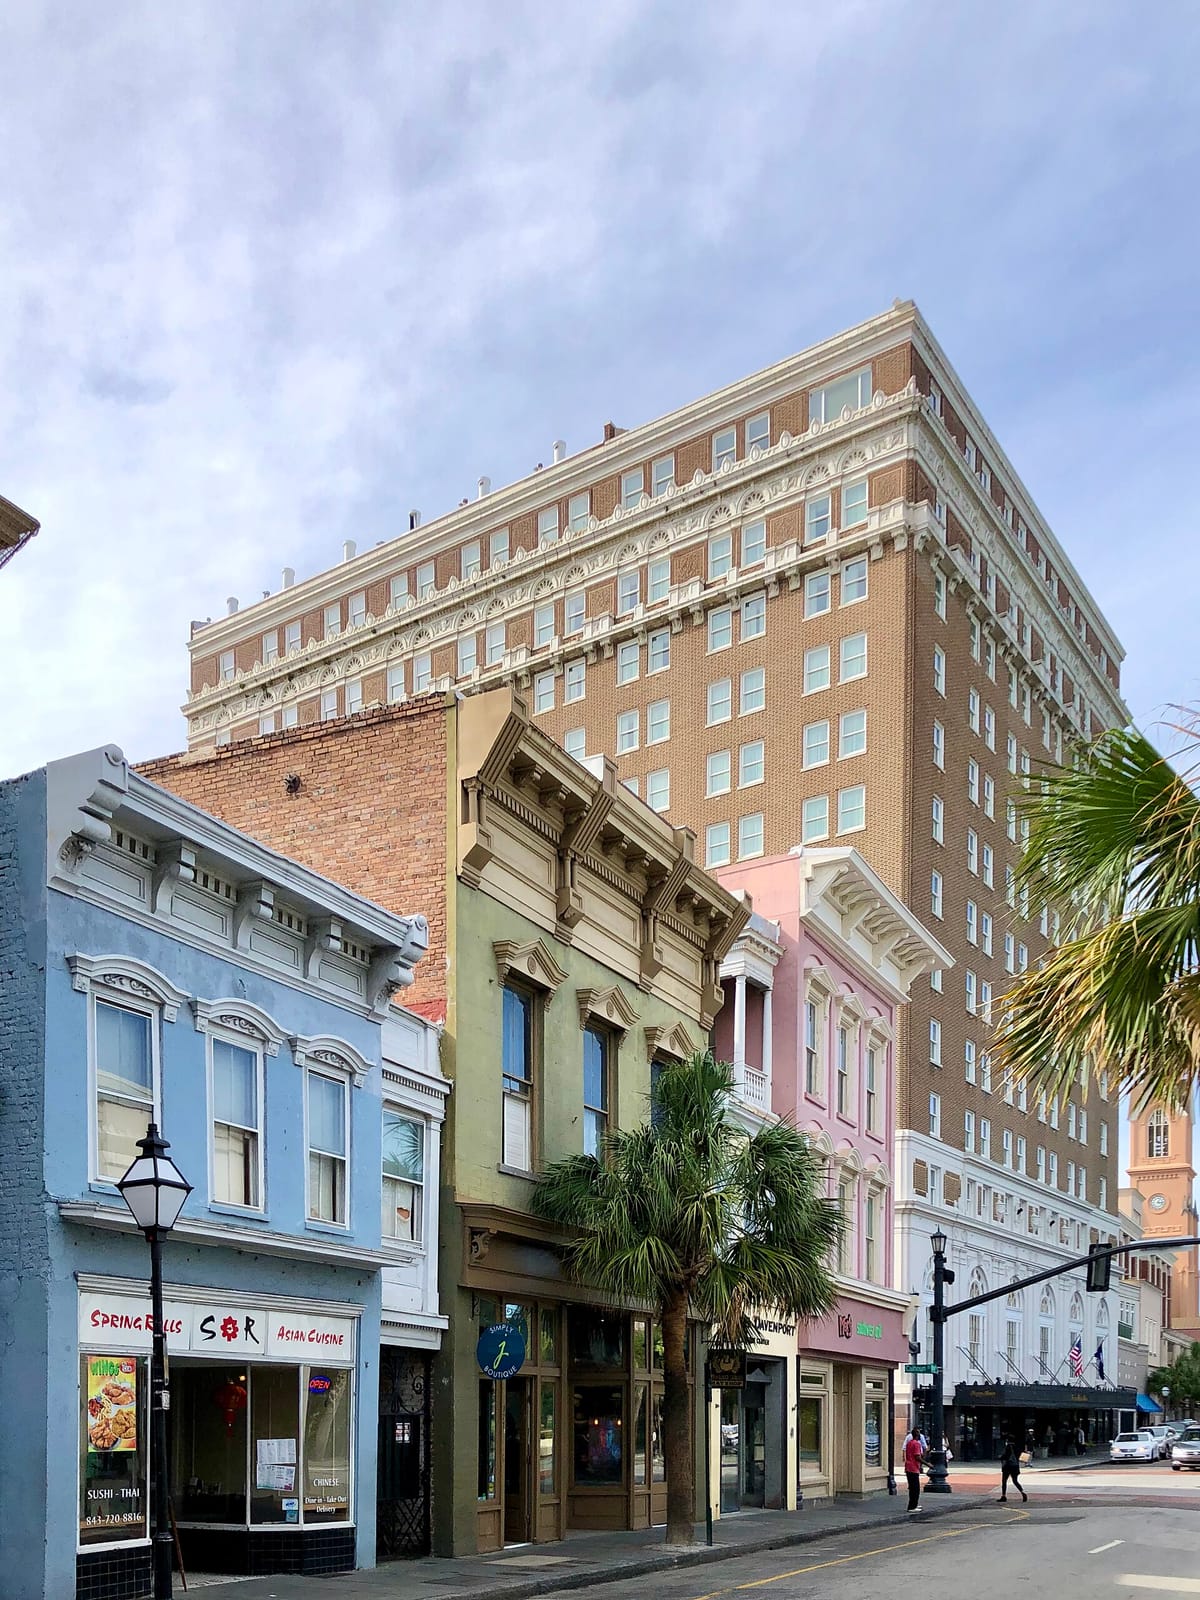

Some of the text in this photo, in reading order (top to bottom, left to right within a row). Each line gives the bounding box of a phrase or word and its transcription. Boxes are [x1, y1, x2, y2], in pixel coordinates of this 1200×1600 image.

[145, 1314, 183, 1334] RLLS
[490, 1324, 514, 1334] SIMPLY
[277, 1326, 344, 1345] ASIAN CUISINE
[484, 1365, 517, 1378] BOUTIQUE
[309, 1380, 330, 1390] OPEN
[313, 1478, 339, 1487] CHINESE
[88, 1489, 113, 1500] SUSHI
[120, 1488, 140, 1498] THAI
[316, 1506, 336, 1514] Delivery
